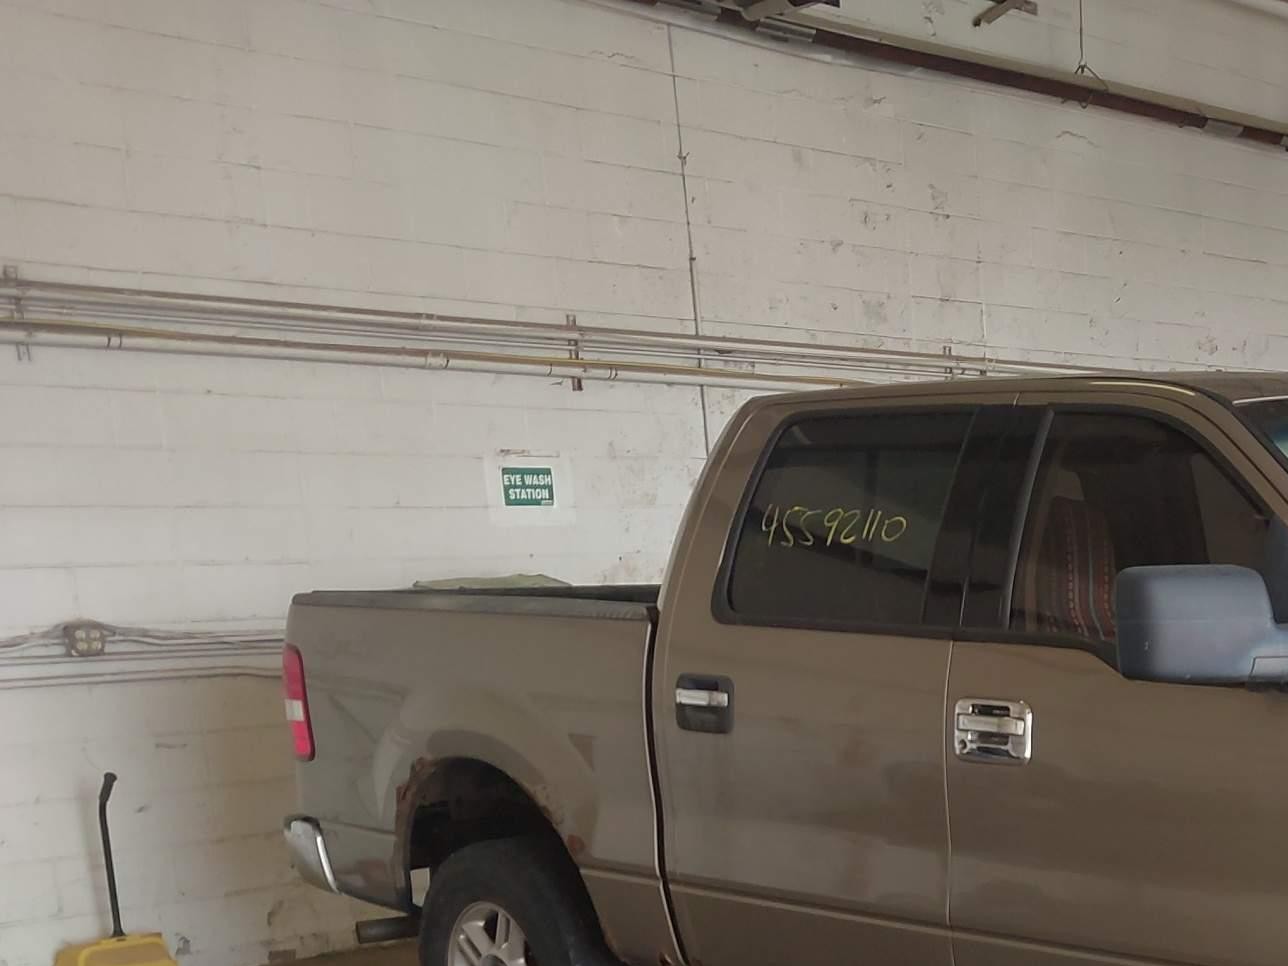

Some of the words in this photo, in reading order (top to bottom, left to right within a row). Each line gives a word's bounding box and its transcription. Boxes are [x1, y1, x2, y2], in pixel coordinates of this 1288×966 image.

[503, 474, 522, 485] EYE
[523, 474, 552, 486] WASH
[508, 488, 550, 500] STATION
[761, 503, 907, 547] 45592110
